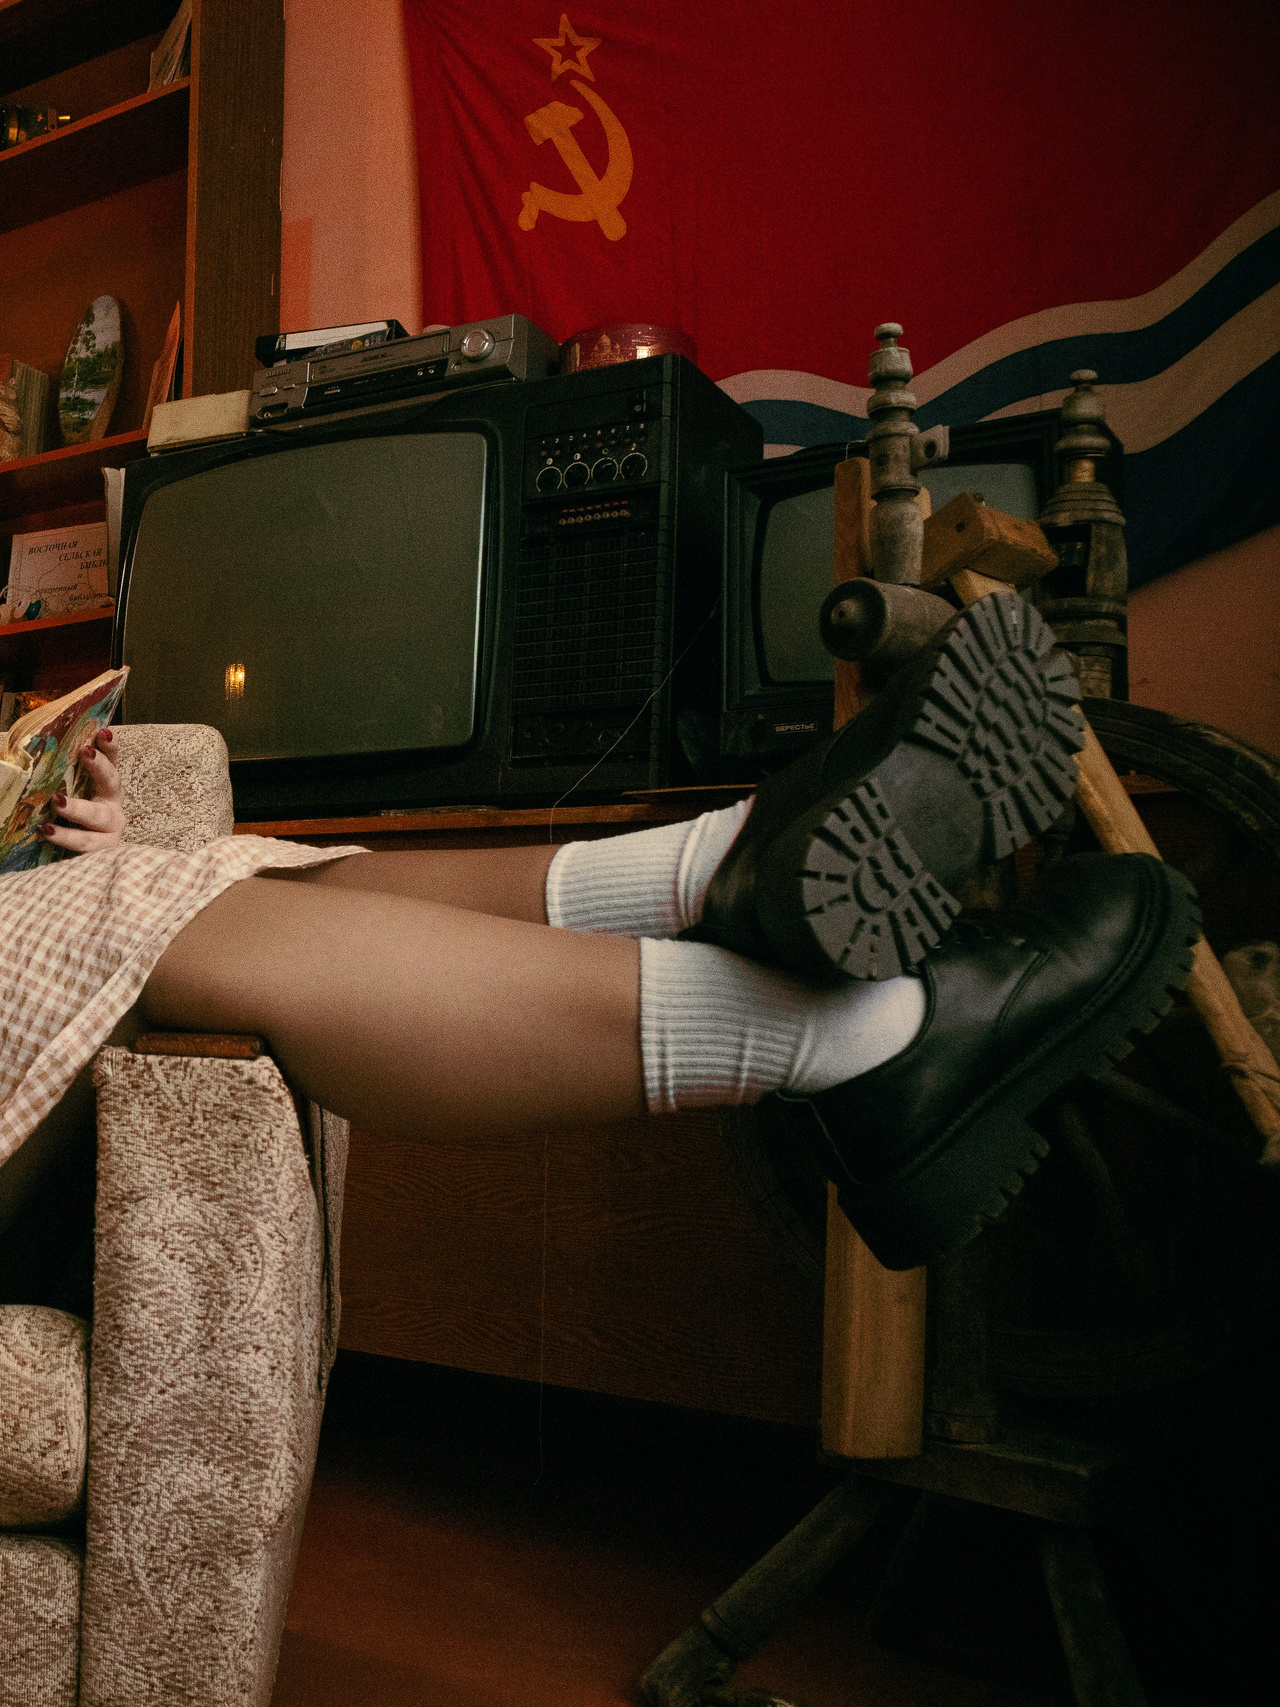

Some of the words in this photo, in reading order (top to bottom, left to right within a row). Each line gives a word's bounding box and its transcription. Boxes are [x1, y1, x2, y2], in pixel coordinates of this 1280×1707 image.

[28, 540, 78, 555] ВОСТОЧНАЯ
[58, 548, 102, 562] СЕЛЬСКАЯ
[775, 722, 815, 732] БЕРЕСТЬЕ
